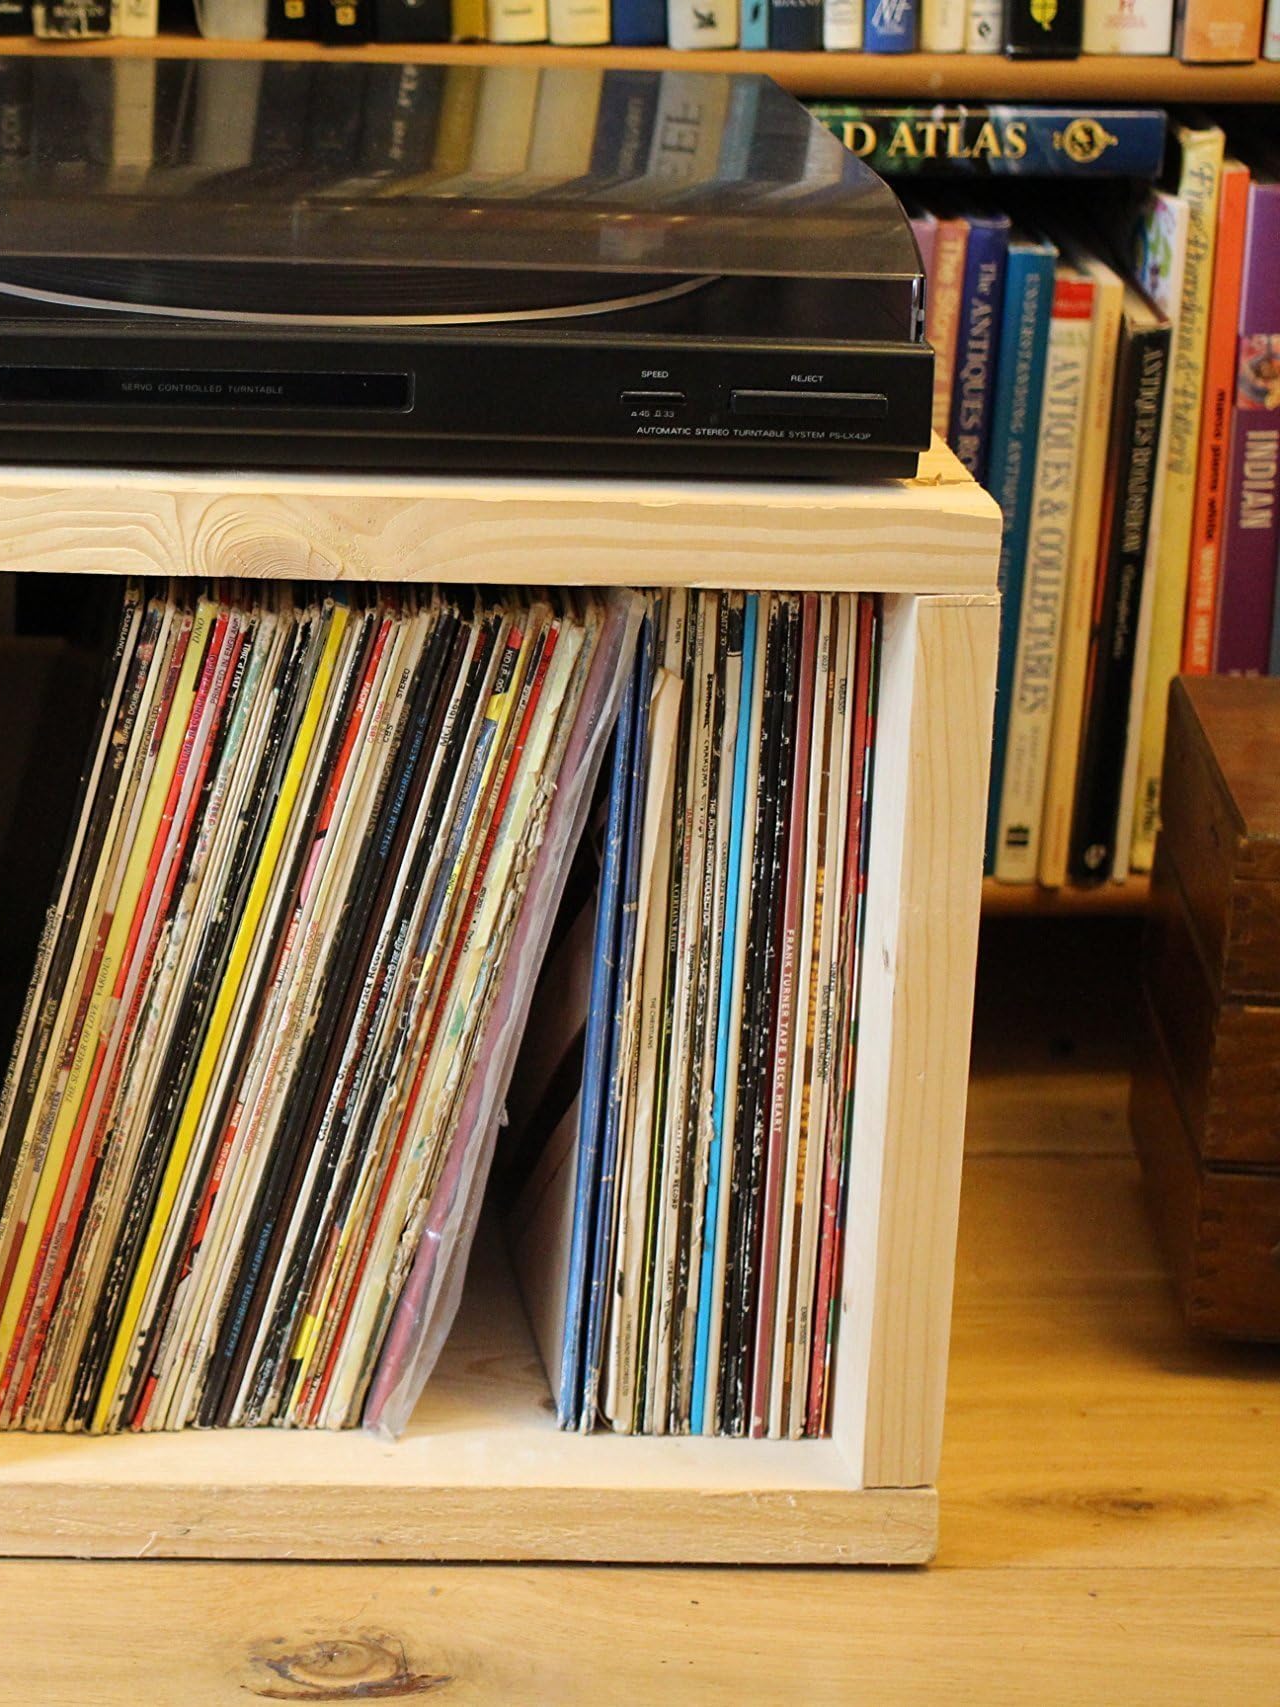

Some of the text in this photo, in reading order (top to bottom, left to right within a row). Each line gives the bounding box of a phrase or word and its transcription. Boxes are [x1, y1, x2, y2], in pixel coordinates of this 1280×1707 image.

[888, 121, 1028, 159] ATLAS
[960, 262, 997, 431] The ANTIQUES
[641, 370, 669, 379] SPEED
[790, 375, 824, 383] REJECT
[121, 383, 284, 394] SERVO CONTROLLED TURNTABLE
[663, 410, 675, 418] 33
[636, 427, 691, 435] AUTOMATIC
[695, 428, 730, 436] STEREO
[733, 429, 785, 438] TURNTABLE
[789, 430, 825, 439] SYSTEM
[1239, 429, 1277, 529] INDIAN
[191, 617, 205, 644] DINO
[239, 642, 250, 660] 2001
[209, 668, 225, 704] PRINTED
[220, 657, 228, 667] IN
[127, 684, 142, 715] DOUBLE
[382, 667, 411, 743] CBS STEREO
[708, 798, 716, 814] THE
[706, 816, 715, 838] JOHN
[704, 839, 714, 874] LENNON
[669, 926, 677, 951] RATIO
[389, 949, 400, 963] THE
[94, 955, 112, 996] VARIOUS
[85, 1003, 99, 1029] LOVE
[646, 1010, 655, 1049] CHRISTIANS
[818, 1009, 827, 1035] MEETS
[81, 1030, 91, 1044] OF
[772, 929, 795, 1132] FRANK TURNER TAPE DECK HEART
[70, 1045, 87, 1084] SUMMER
[815, 1036, 825, 1078] ELLINGTON
[65, 1085, 76, 1103] THE
[40, 1090, 61, 1145] SPRINGSTEEN
[38, 1261, 54, 1299] SOLITUDE
[49, 1221, 66, 1260] STANDING
